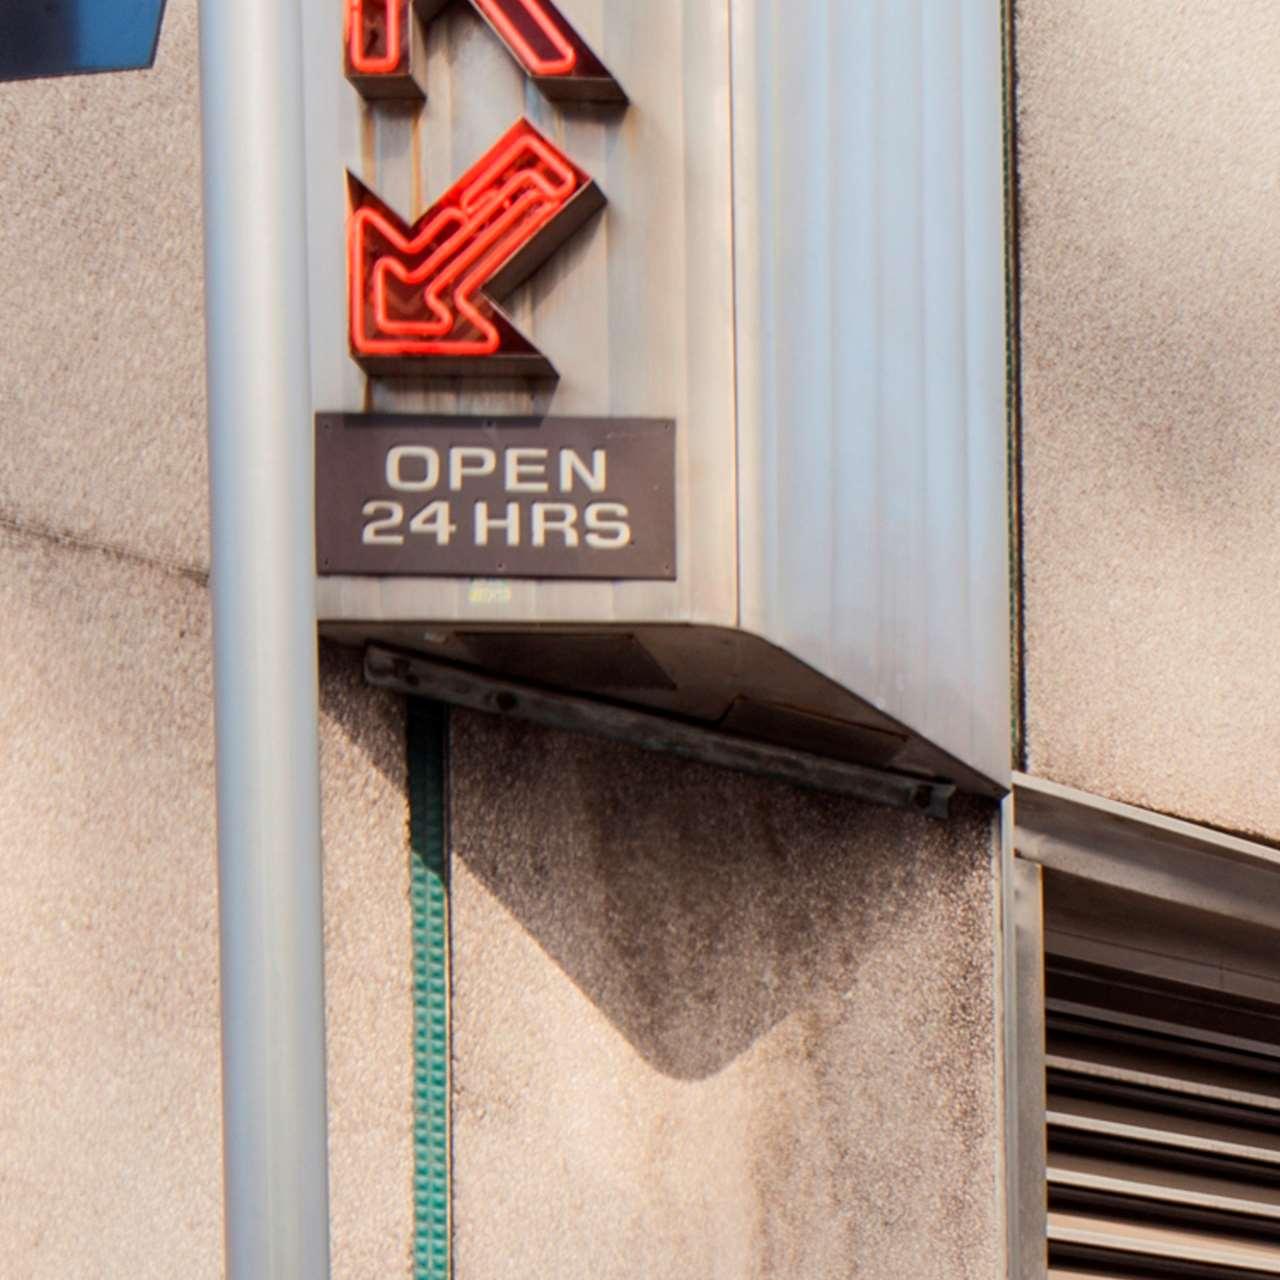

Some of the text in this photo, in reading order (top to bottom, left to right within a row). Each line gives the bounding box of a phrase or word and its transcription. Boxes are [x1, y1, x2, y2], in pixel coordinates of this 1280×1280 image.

[385, 446, 606, 492] OPEN
[362, 500, 631, 549] 24 HRS
